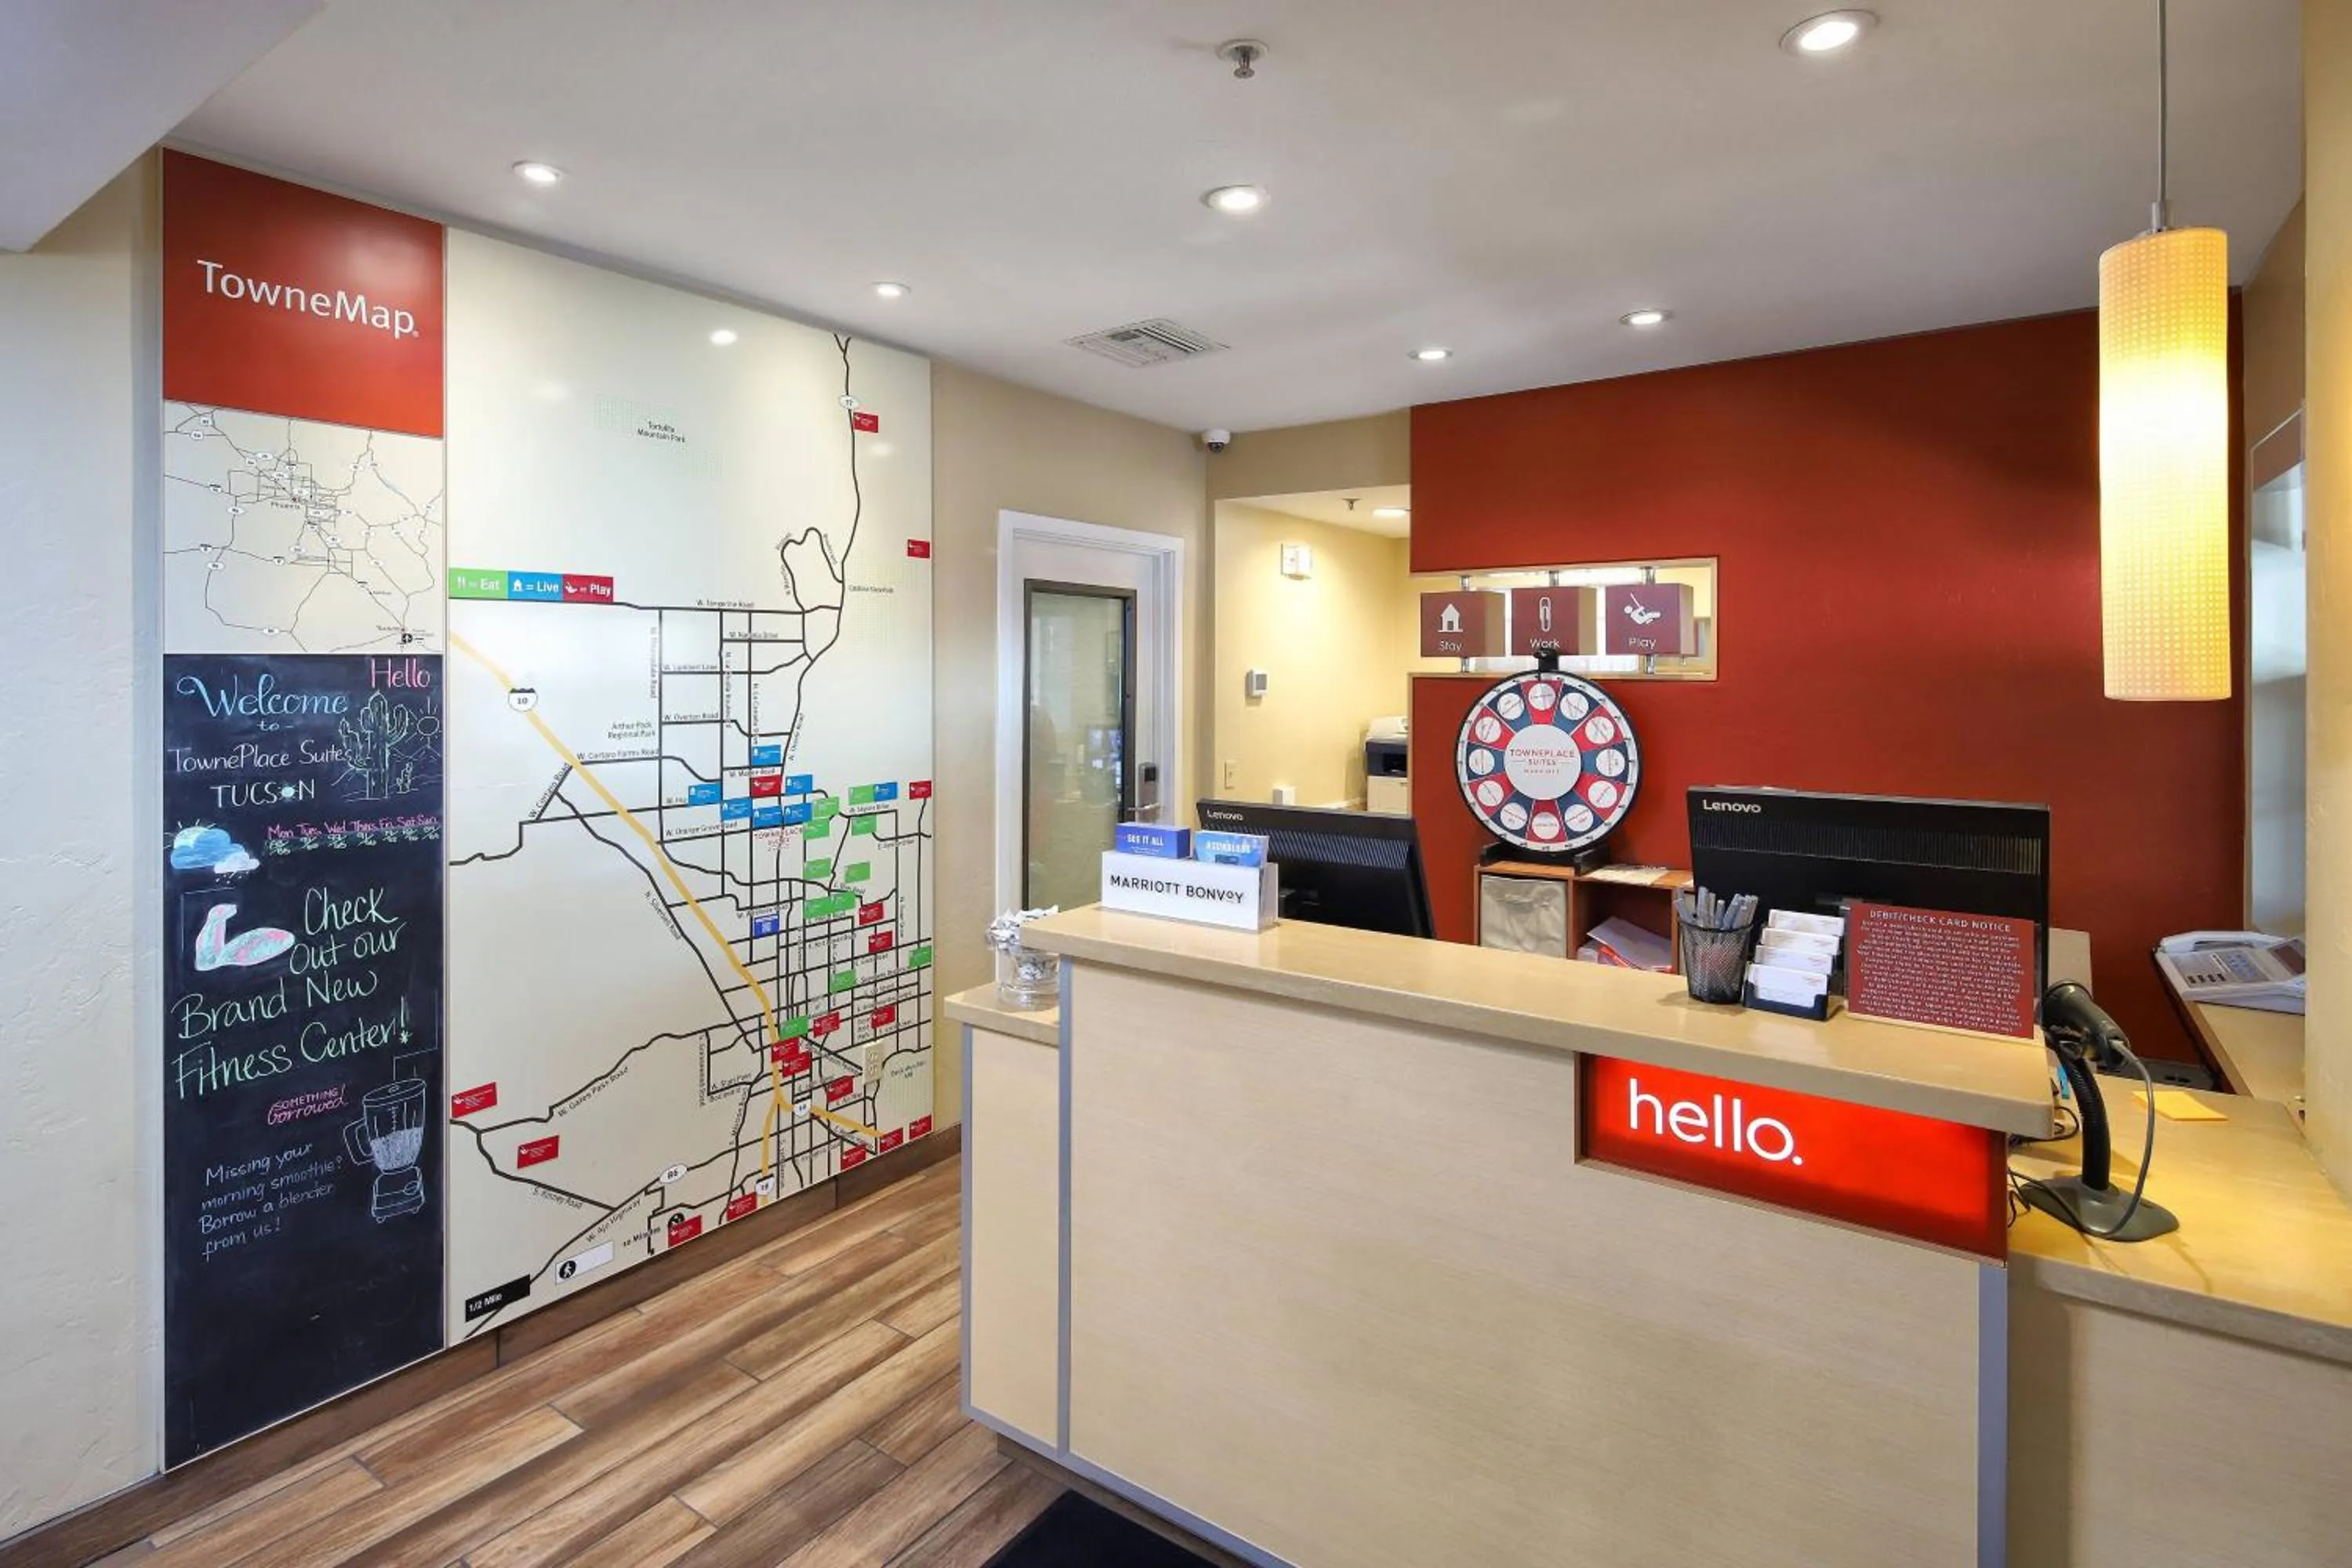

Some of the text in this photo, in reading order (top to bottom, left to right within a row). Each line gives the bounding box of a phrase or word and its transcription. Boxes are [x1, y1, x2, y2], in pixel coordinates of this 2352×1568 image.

[480, 579, 499, 590] Eat
[537, 580, 559, 593] Live
[590, 583, 612, 597] Play
[1438, 641, 1463, 653] Stay
[1530, 637, 1561, 650] Work
[1628, 637, 1657, 650] Play
[370, 658, 430, 688] Hello
[176, 673, 350, 717] Welcome
[256, 720, 280, 731] to
[167, 739, 353, 772] TownePlace Suites
[1509, 749, 1576, 758] TOWNEPLACE
[210, 779, 314, 808] TUCSON
[1207, 808, 1244, 821] Lenovo
[1702, 798, 1762, 815] Lenovo
[267, 824, 294, 840] Mon
[325, 820, 346, 834] Wed
[1109, 874, 1181, 895] MARRIOTT
[305, 887, 398, 935] Check
[1870, 910, 2012, 932] DEBIT/CHECK CARD NOTICE
[289, 921, 407, 975] Out our
[170, 970, 378, 1040] Brand New
[170, 996, 412, 1098] Fitness Center!
[1628, 1077, 1803, 1166] hello.
[205, 1142, 313, 1186] Missing your
[201, 1181, 266, 1211] morning
[198, 1181, 336, 1235] Borrow a blender
[201, 1215, 283, 1263] from us!
[484, 1293, 503, 1306] Mile
